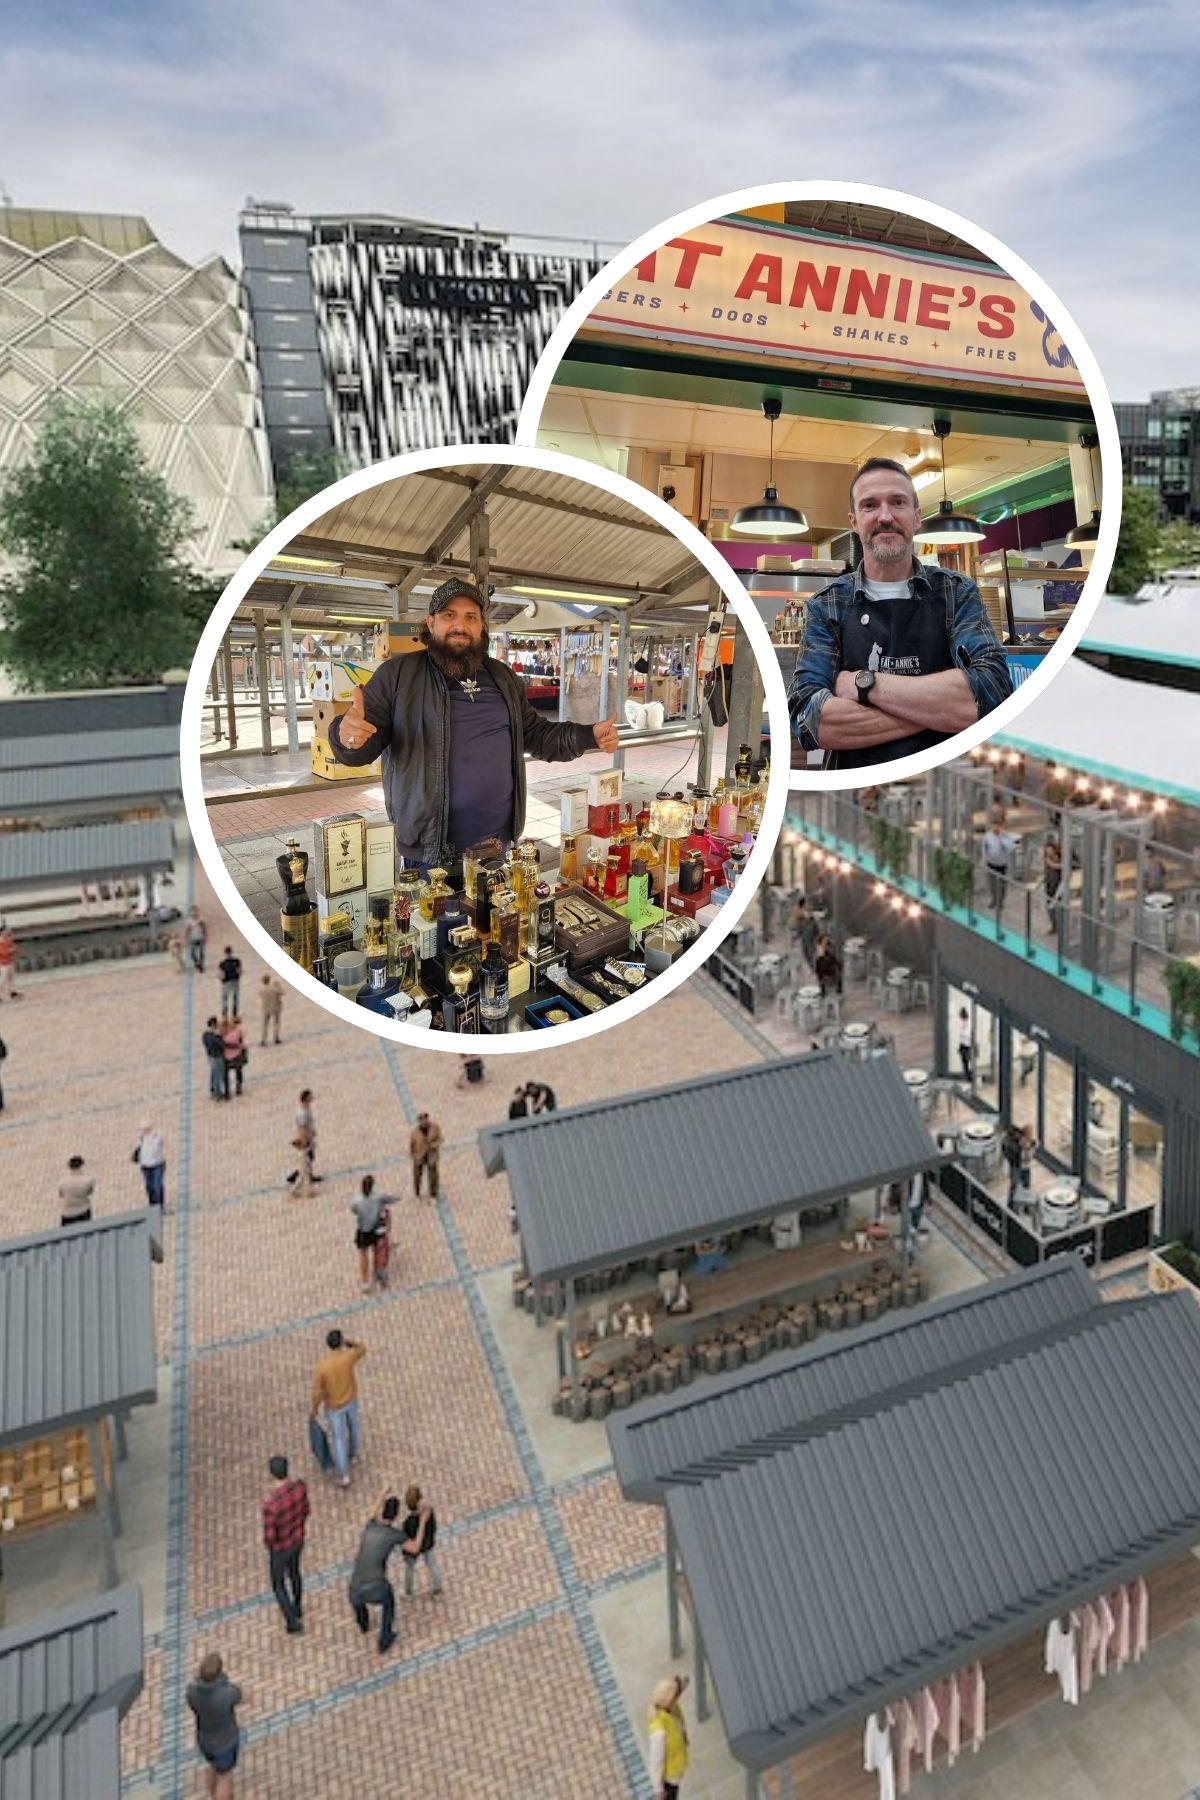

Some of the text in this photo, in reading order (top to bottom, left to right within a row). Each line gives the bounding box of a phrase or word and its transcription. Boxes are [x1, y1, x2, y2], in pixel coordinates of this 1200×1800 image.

[734, 252, 1016, 339] ANNIE'S
[711, 307, 768, 327] DOGS
[832, 326, 910, 346] SHAKES
[965, 345, 1018, 362] FRIES
